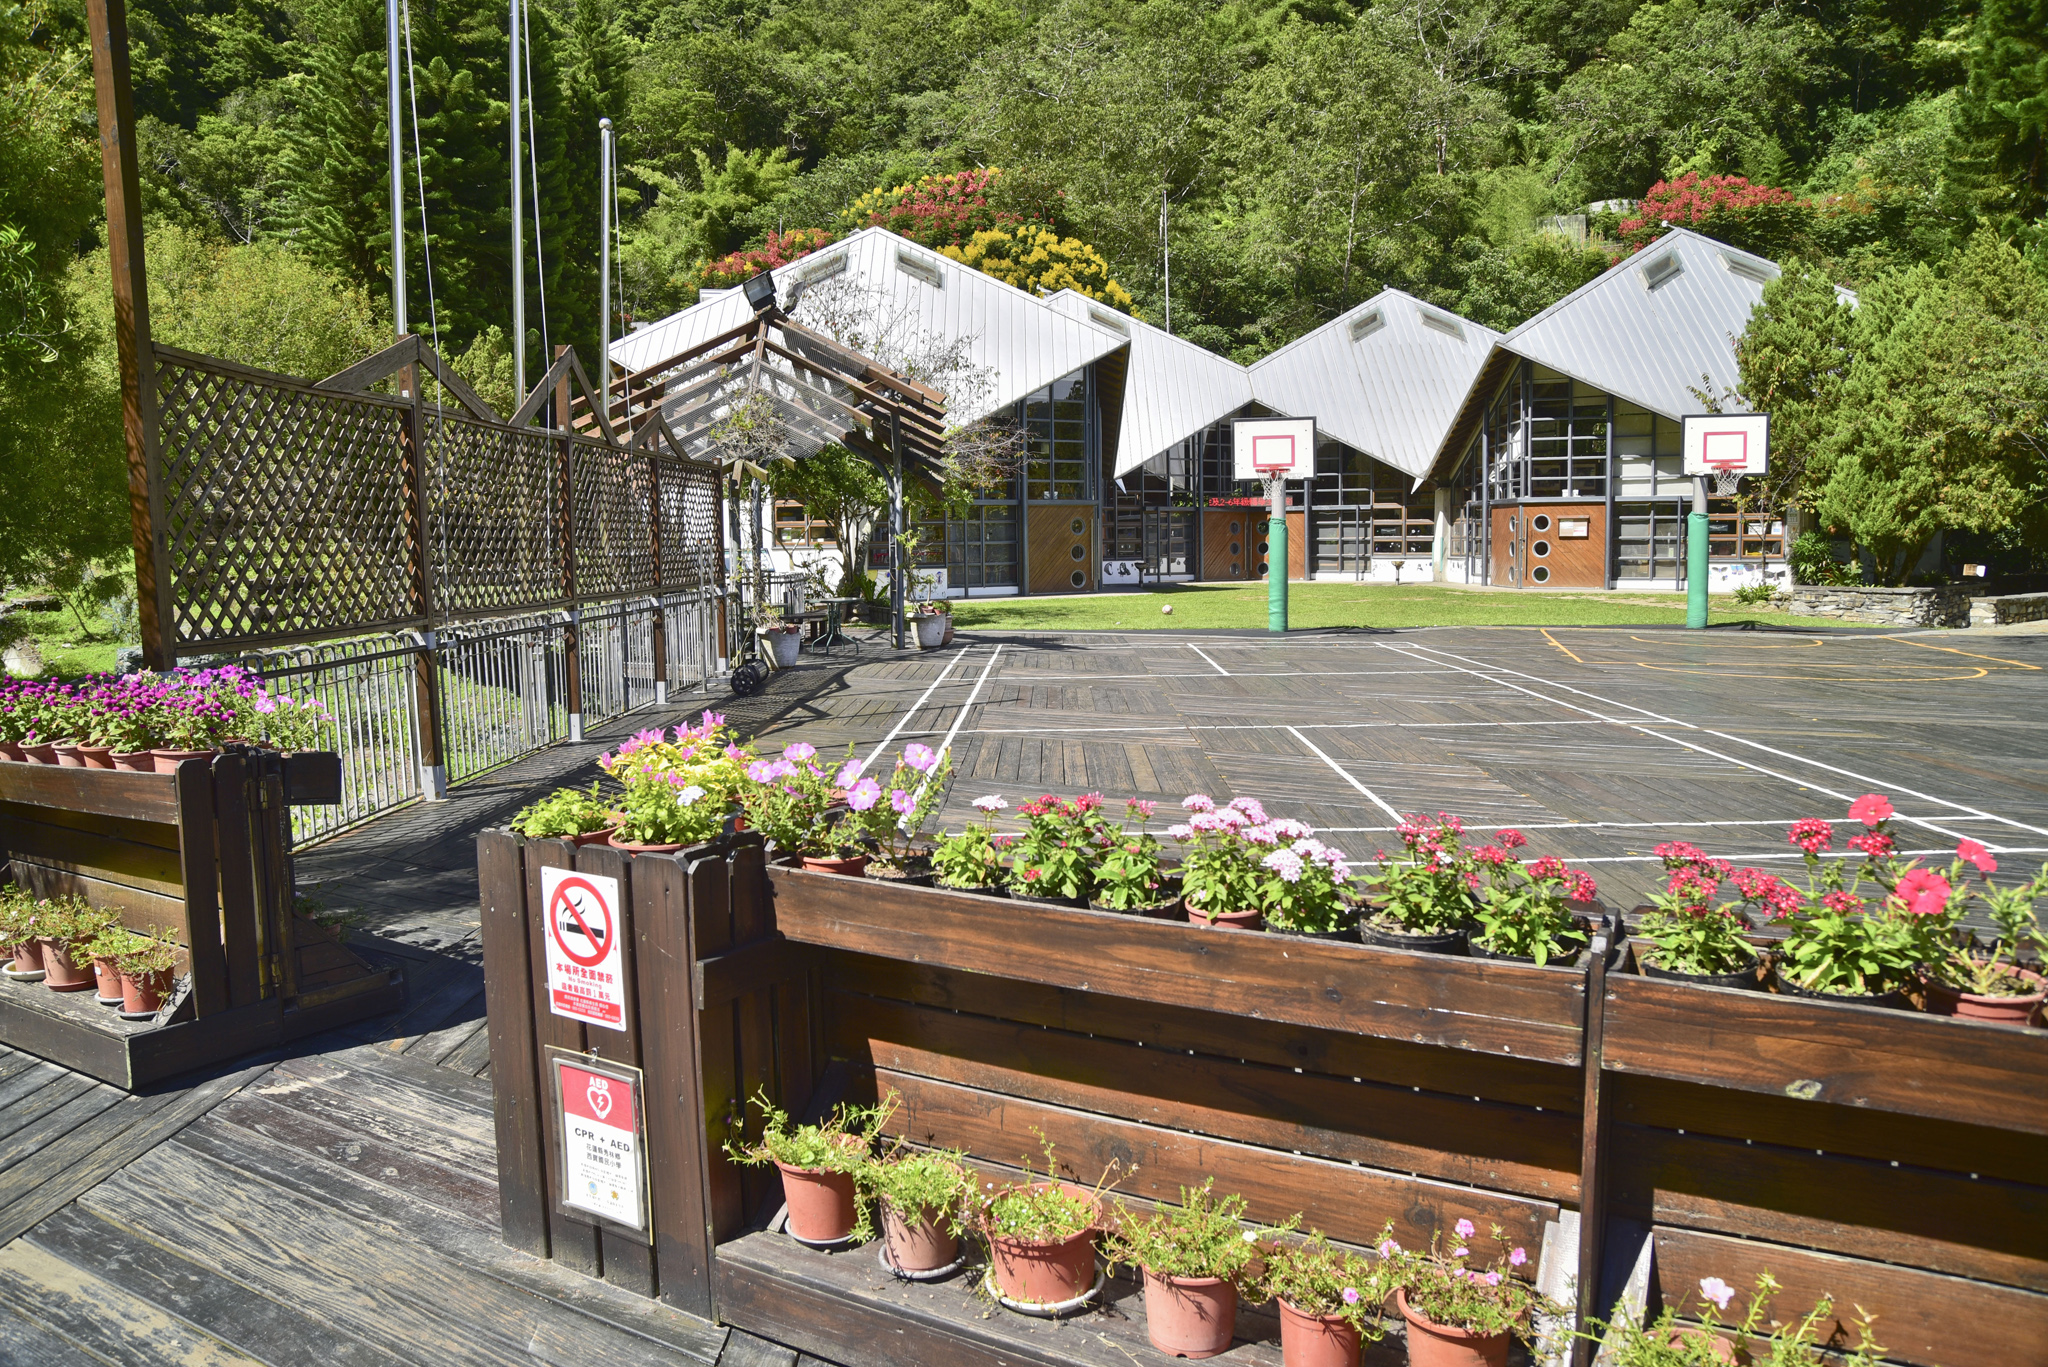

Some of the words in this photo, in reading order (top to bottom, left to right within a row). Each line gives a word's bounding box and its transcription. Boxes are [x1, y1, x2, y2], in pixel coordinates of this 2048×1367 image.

[556, 962, 613, 985] 本場所全面禁菸
[577, 977, 602, 990] Smoking
[588, 1076, 609, 1090] AED
[574, 1127, 595, 1141] CPR
[610, 1139, 631, 1152] AED
